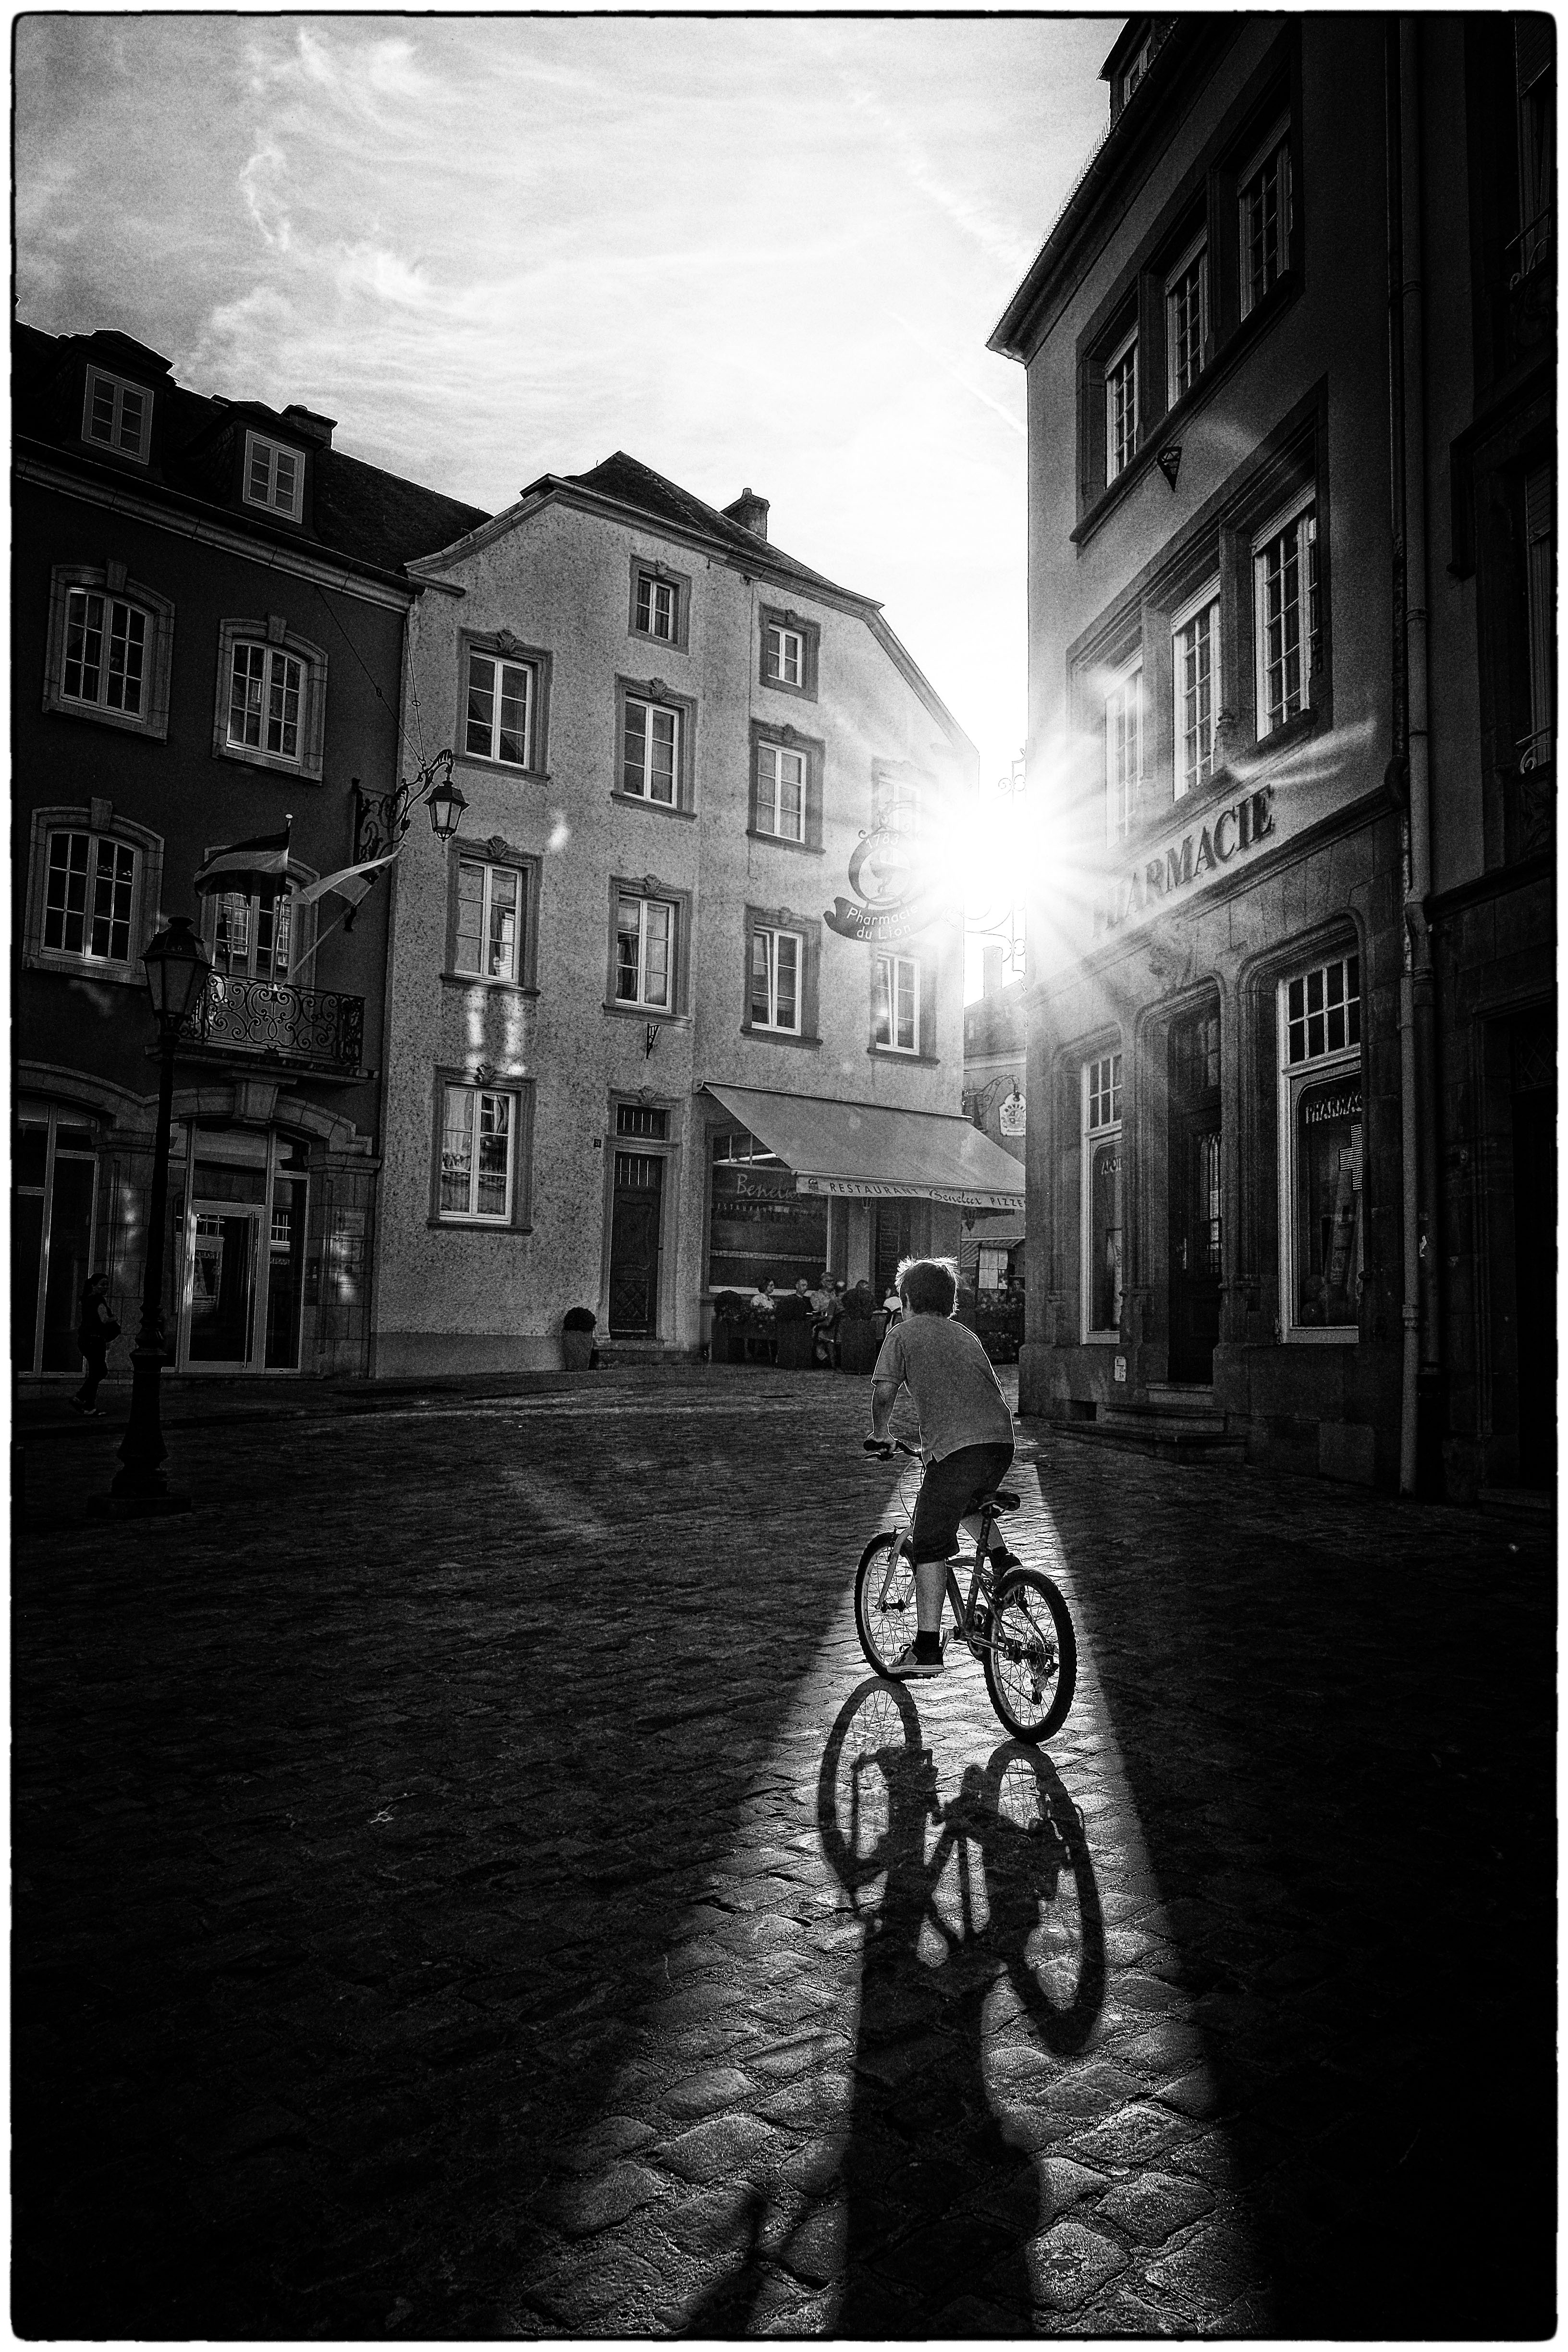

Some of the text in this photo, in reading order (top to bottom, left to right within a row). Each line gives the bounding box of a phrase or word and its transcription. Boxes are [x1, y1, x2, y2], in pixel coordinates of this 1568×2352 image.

[866, 832, 899, 849] 1783
[846, 904, 919, 925] Pharmacie
[857, 925, 911, 940] du Lion
[830, 1182, 919, 1196] RESTAURANT
[929, 1188, 982, 1207] Benelux
